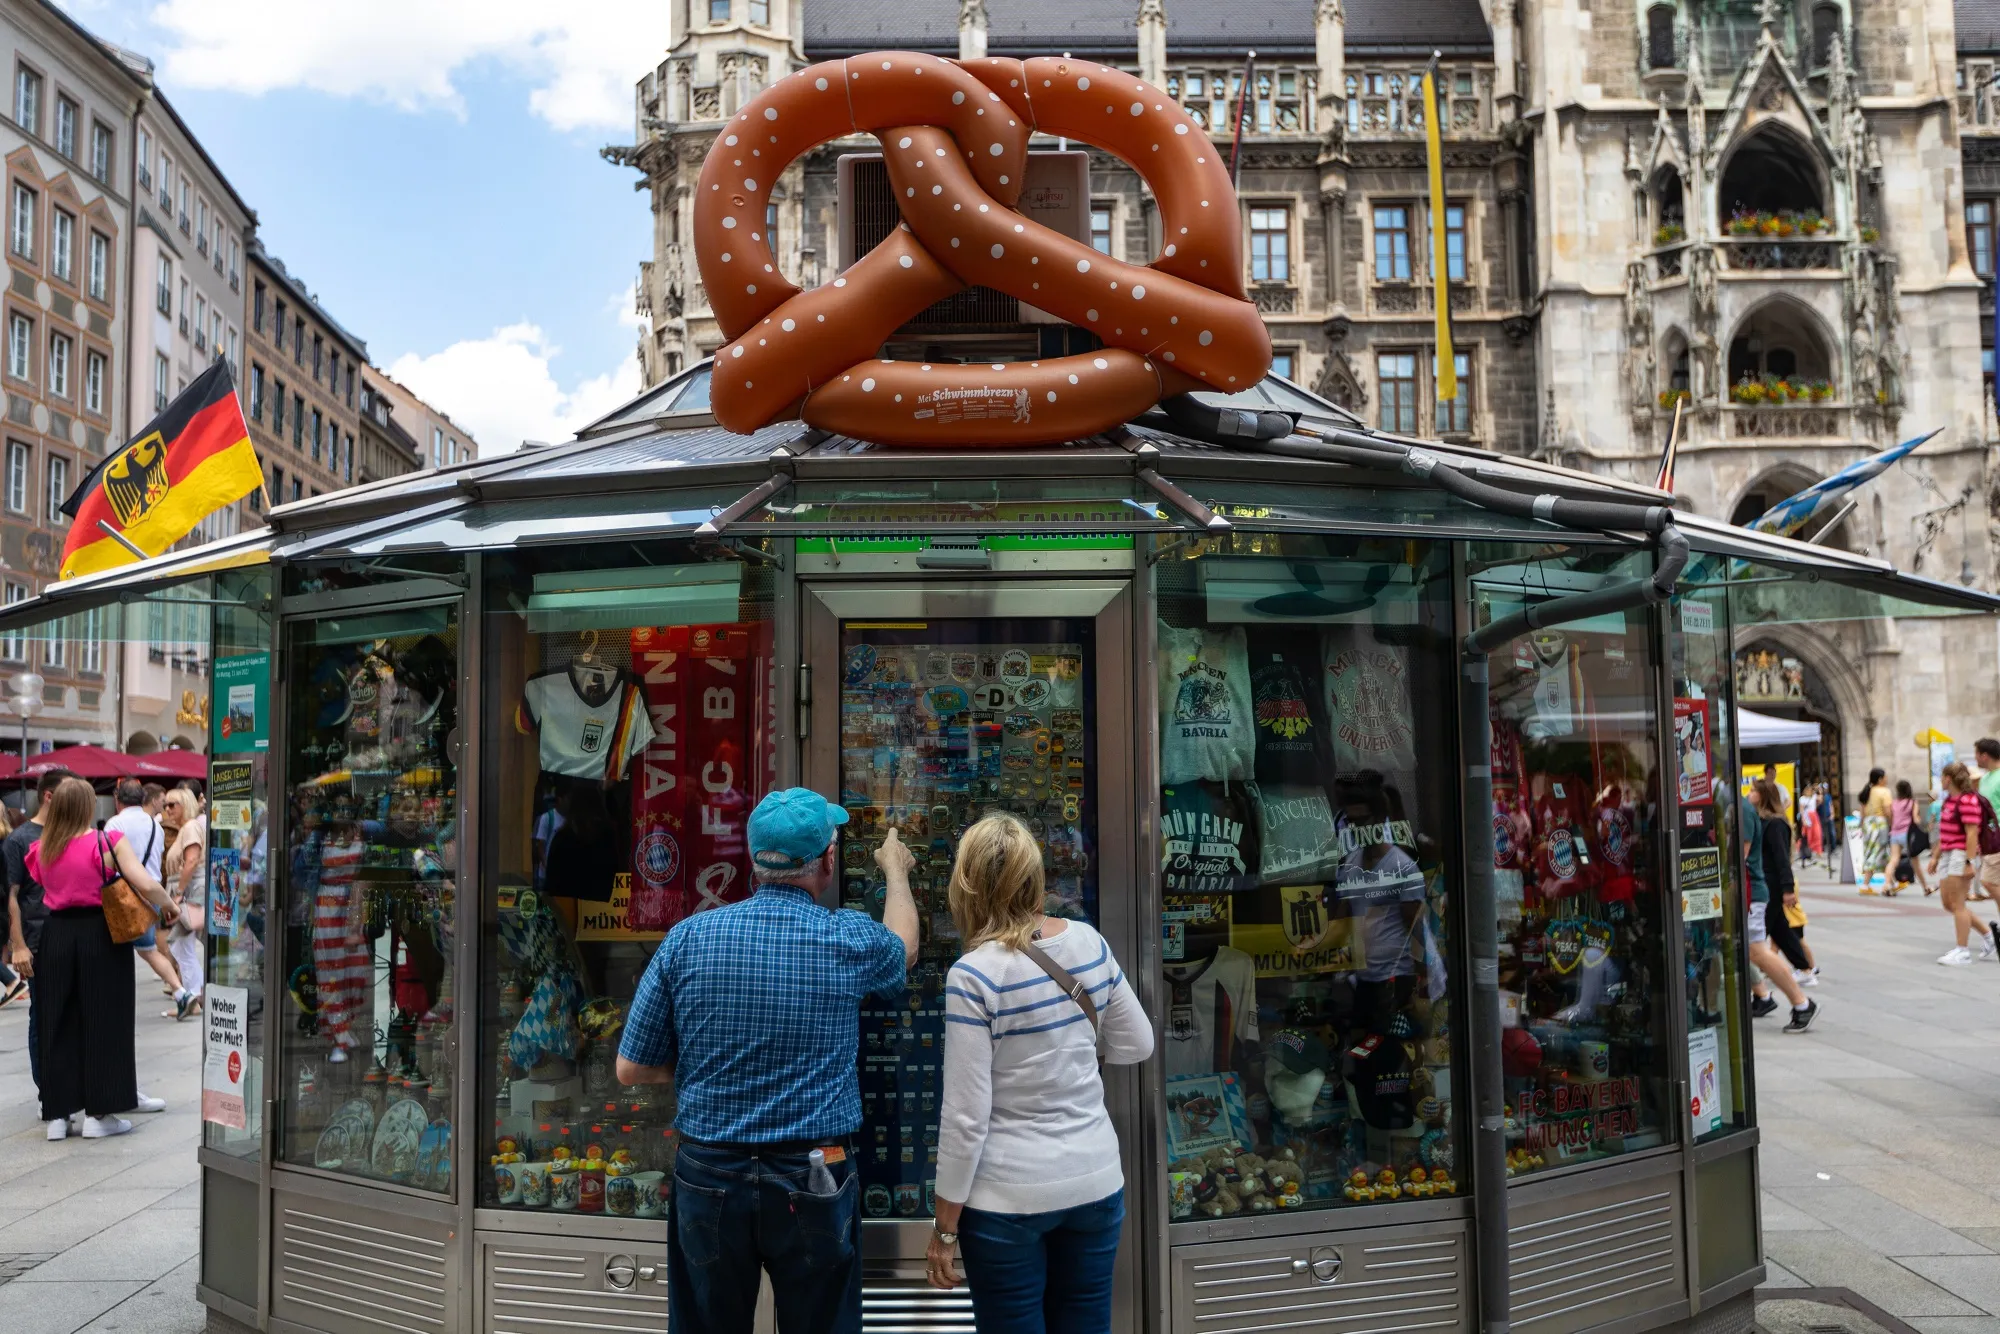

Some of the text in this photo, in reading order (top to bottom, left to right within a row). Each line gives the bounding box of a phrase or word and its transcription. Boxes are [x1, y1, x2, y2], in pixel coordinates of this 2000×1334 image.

[918, 385, 1014, 404] Mei Schwimmbrezn
[989, 688, 1004, 707] D
[233, 767, 250, 779] TEAM
[702, 760, 735, 836] FC
[1264, 796, 1335, 830] ÜNCHEN
[1686, 810, 1703, 826] BUNTE
[1202, 845, 1218, 853] ITY
[1680, 854, 1717, 873] NSER TEAM
[613, 897, 628, 908] au
[1365, 887, 1403, 899] GERMANY
[583, 912, 632, 930] MÜNC
[1555, 941, 1578, 953] PEACE
[1254, 946, 1353, 971] MÜNCHEN
[210, 996, 236, 1015] Woher
[210, 1012, 238, 1031] kommt
[210, 1028, 243, 1048] der Mut?
[1519, 1075, 1640, 1119] FC BAYERN
